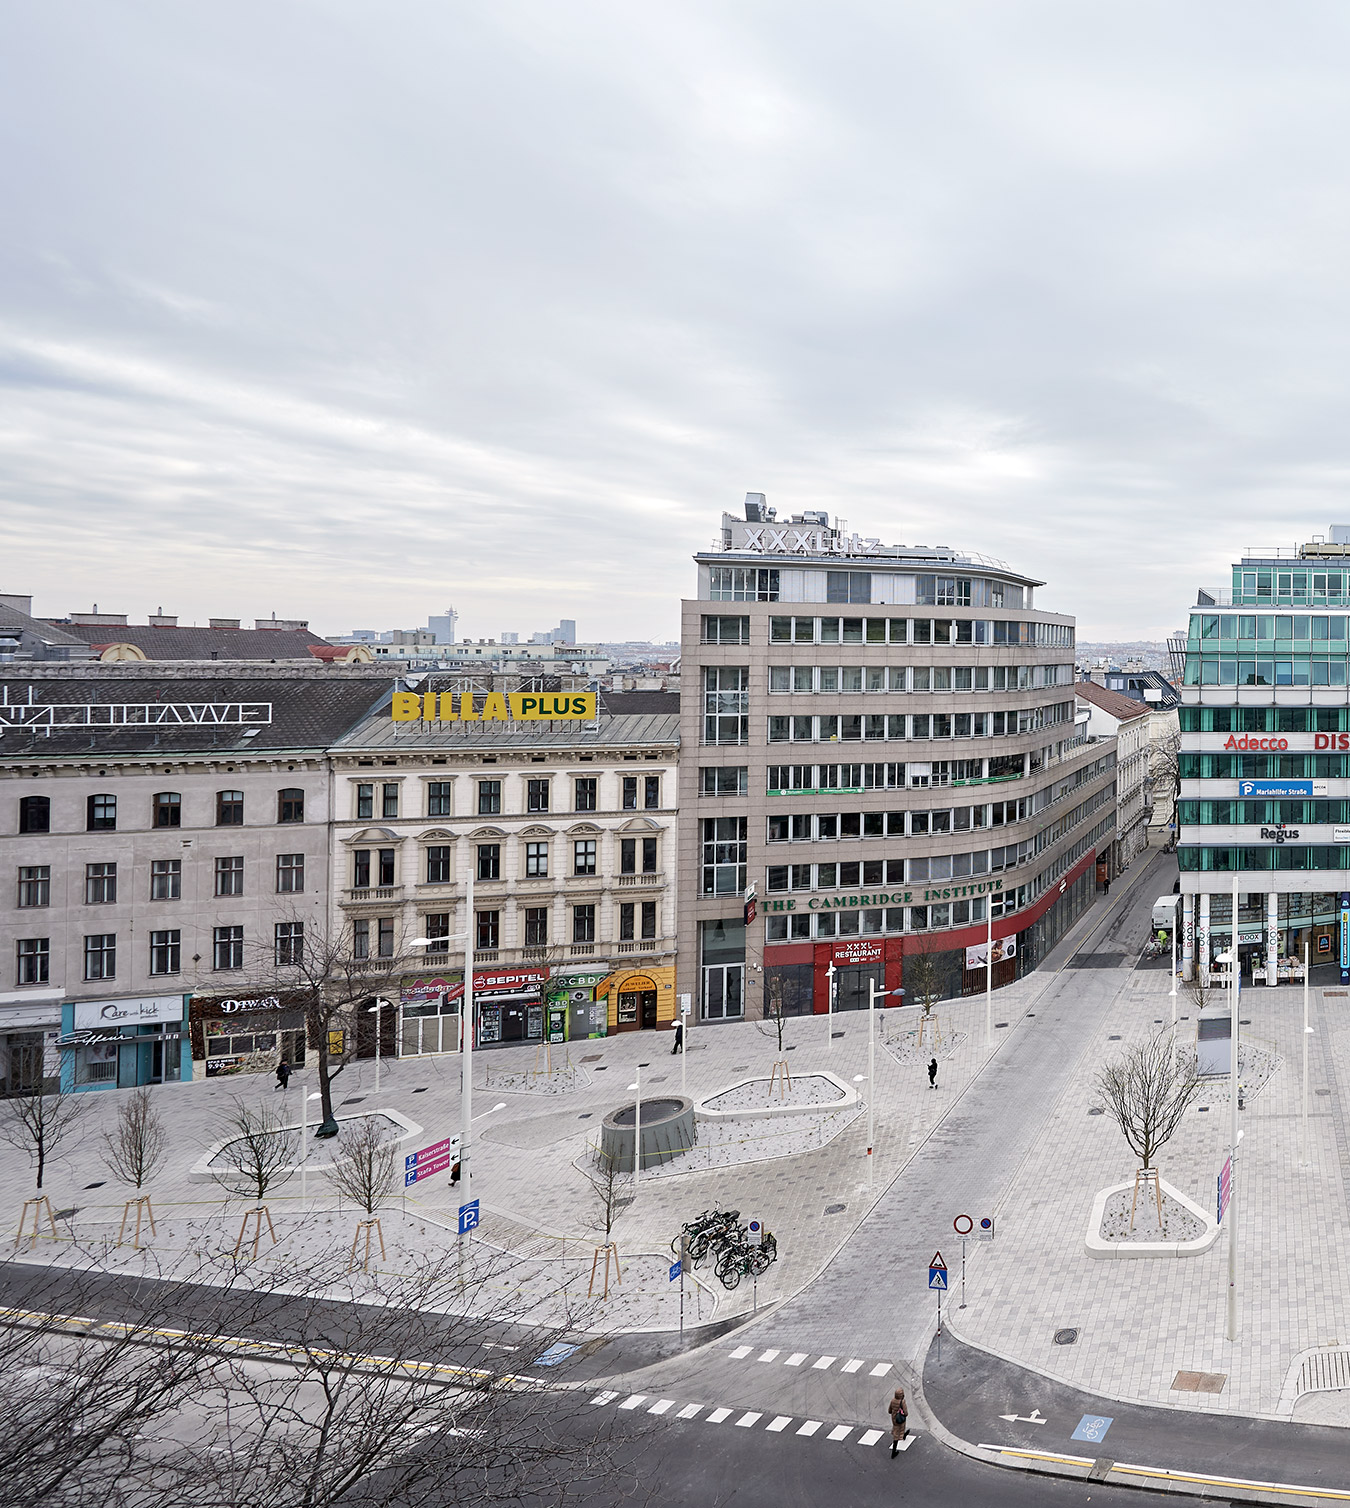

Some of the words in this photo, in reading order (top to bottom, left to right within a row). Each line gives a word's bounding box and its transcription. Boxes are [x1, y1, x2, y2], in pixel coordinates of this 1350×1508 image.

[743, 527, 881, 555] XXXLutz
[391, 692, 509, 721] BILLA
[521, 697, 587, 715] PLUS
[1223, 733, 1289, 750] Adecco
[1314, 733, 1350, 750] DIS
[1256, 788, 1288, 796] Mariahilfer
[1288, 788, 1308, 796] Straße
[1260, 827, 1300, 844] Regus
[760, 899, 797, 912] THE
[808, 891, 913, 910] CAMBRIDGE
[924, 879, 1003, 901] INSTITUTE
[1240, 933, 1259, 941] BOOX
[1269, 925, 1277, 952] BOOX
[835, 948, 881, 959] RESTAURANT
[846, 942, 873, 950] XXXL
[486, 974, 545, 986] SEPITEL
[568, 976, 597, 986] CBD
[418, 1143, 449, 1160] Kaiserstraße
[417, 1167, 431, 1178] Stafa
[433, 1159, 449, 1169] Tower
